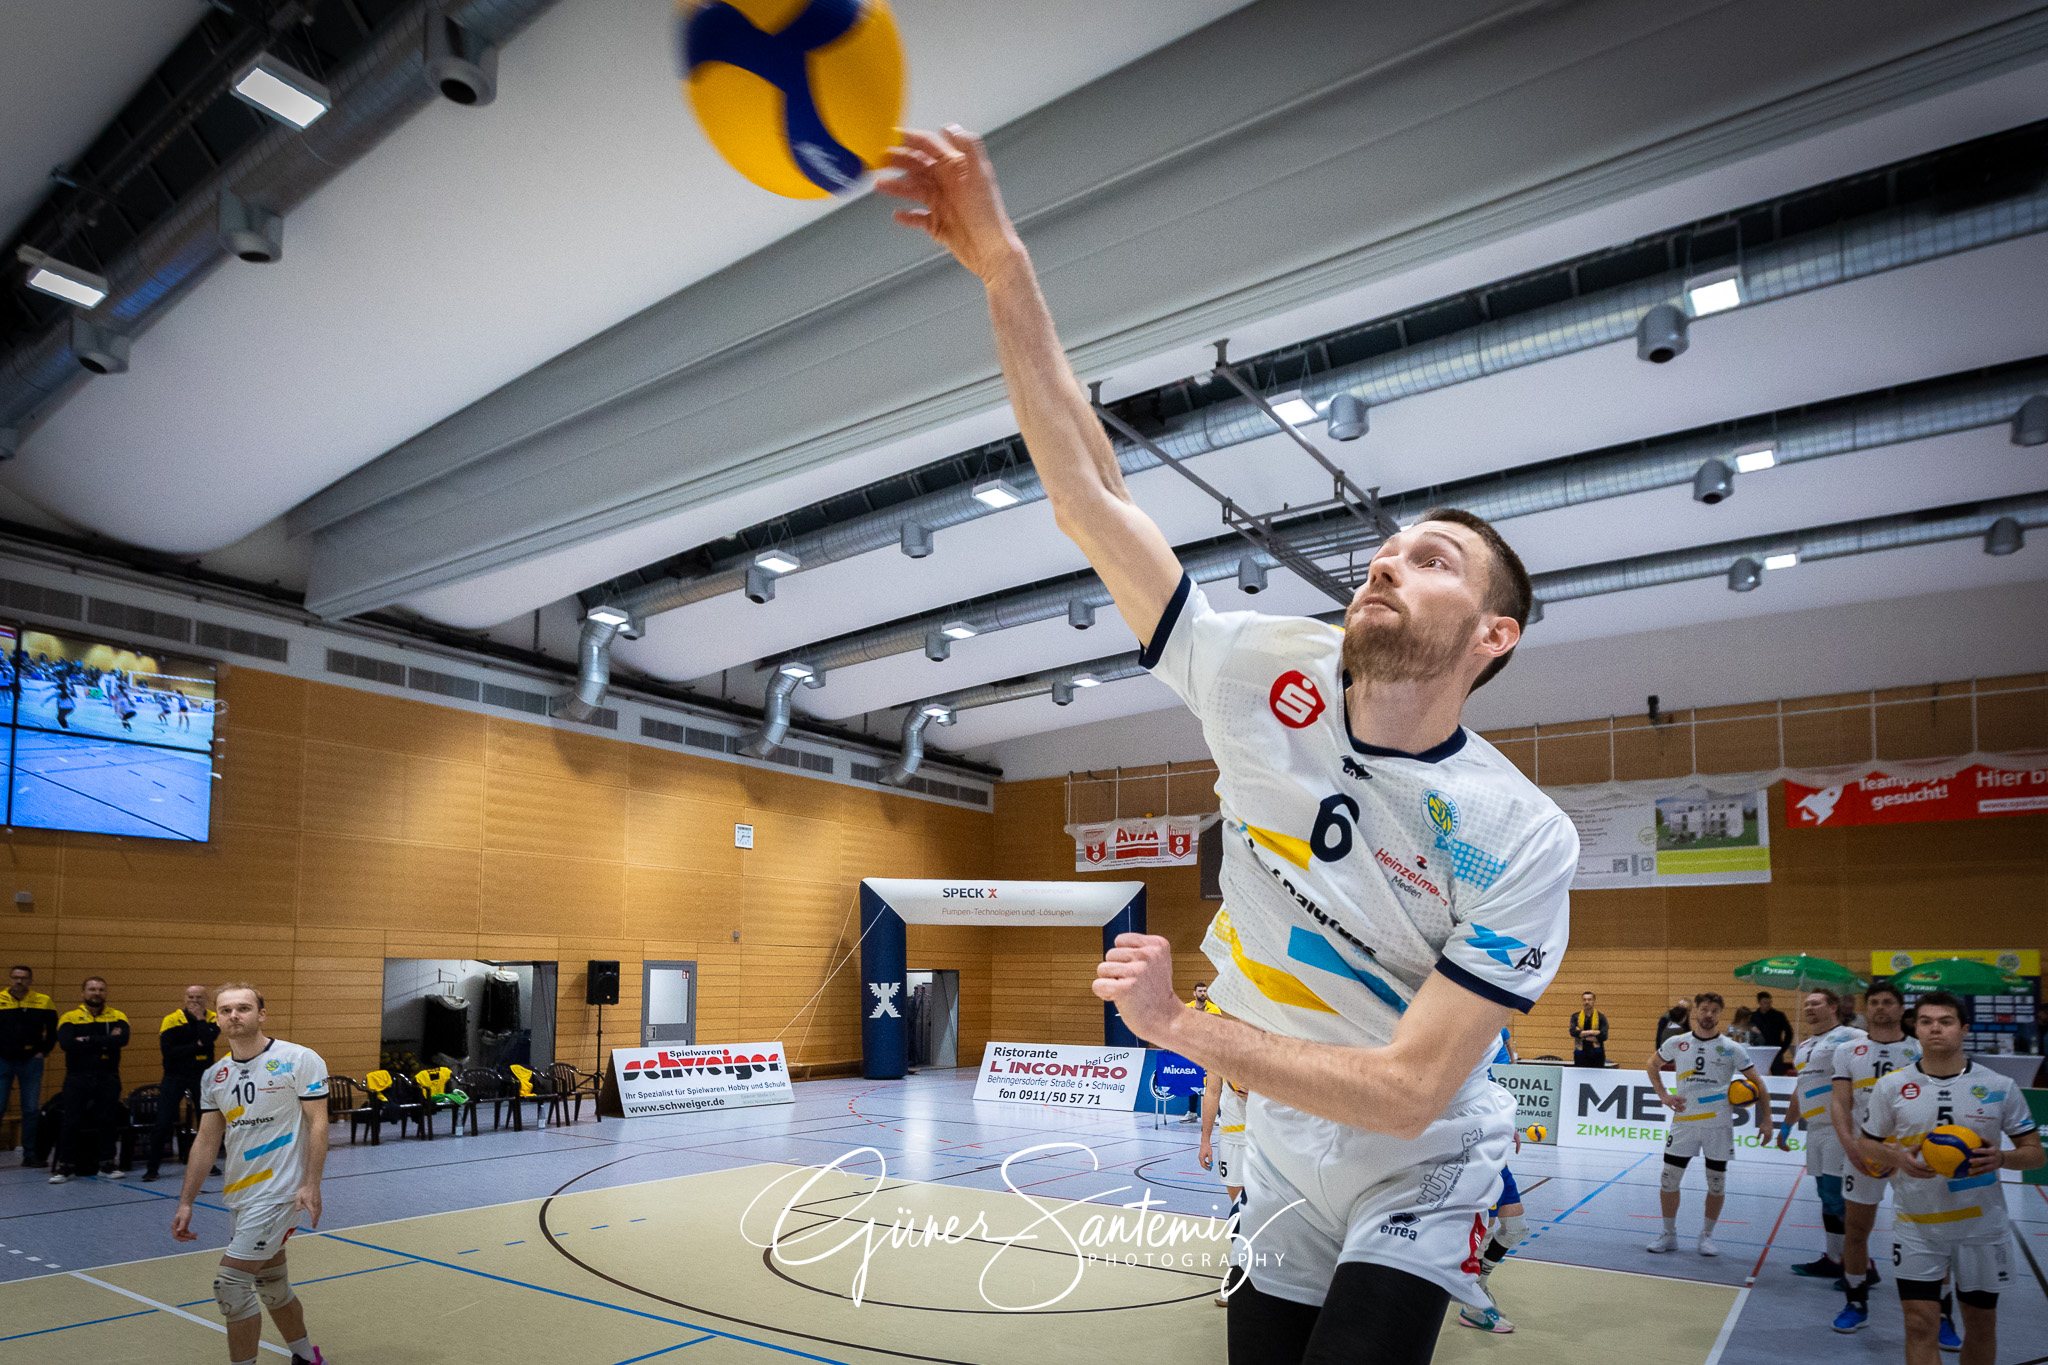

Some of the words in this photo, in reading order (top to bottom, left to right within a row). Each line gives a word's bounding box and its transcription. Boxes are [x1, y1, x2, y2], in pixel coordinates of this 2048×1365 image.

[1976, 769, 2026, 788] Hier
[1871, 784, 1949, 811] gesucht!
[1310, 793, 1360, 863] 6
[1374, 848, 1448, 906] Heinzelma
[942, 888, 984, 898] SPECK
[1391, 875, 1422, 899] Medien
[941, 907, 1021, 916] Pumpen-Technologien
[669, 1049, 722, 1058] Spielwaren
[993, 1047, 1058, 1059] Ristorante
[1103, 1051, 1130, 1064] Gino
[623, 1049, 779, 1081] schweiger
[1695, 1056, 1705, 1071] 9
[625, 1092, 636, 1100] Ihr
[638, 1088, 674, 1099] Spezialist
[675, 1087, 685, 1096] für
[728, 1082, 749, 1092] Hobby
[751, 1082, 763, 1090] und
[764, 1080, 786, 1088] Schule
[987, 1074, 1049, 1087] Behringersdorfer
[1050, 1078, 1076, 1088] Straße
[1077, 1080, 1083, 1088] 6
[1092, 1081, 1125, 1092] Schwaig
[1494, 1077, 1553, 1091] SONAL
[231, 1081, 256, 1107] 10
[999, 1088, 1016, 1099] fon
[1018, 1089, 1067, 1104] 0911/50
[1069, 1093, 1083, 1103] 57
[1087, 1094, 1101, 1104] 71
[629, 1098, 725, 1114] www.schweiger.de
[1936, 1106, 1954, 1127] 5
[1666, 1135, 1673, 1147] 9
